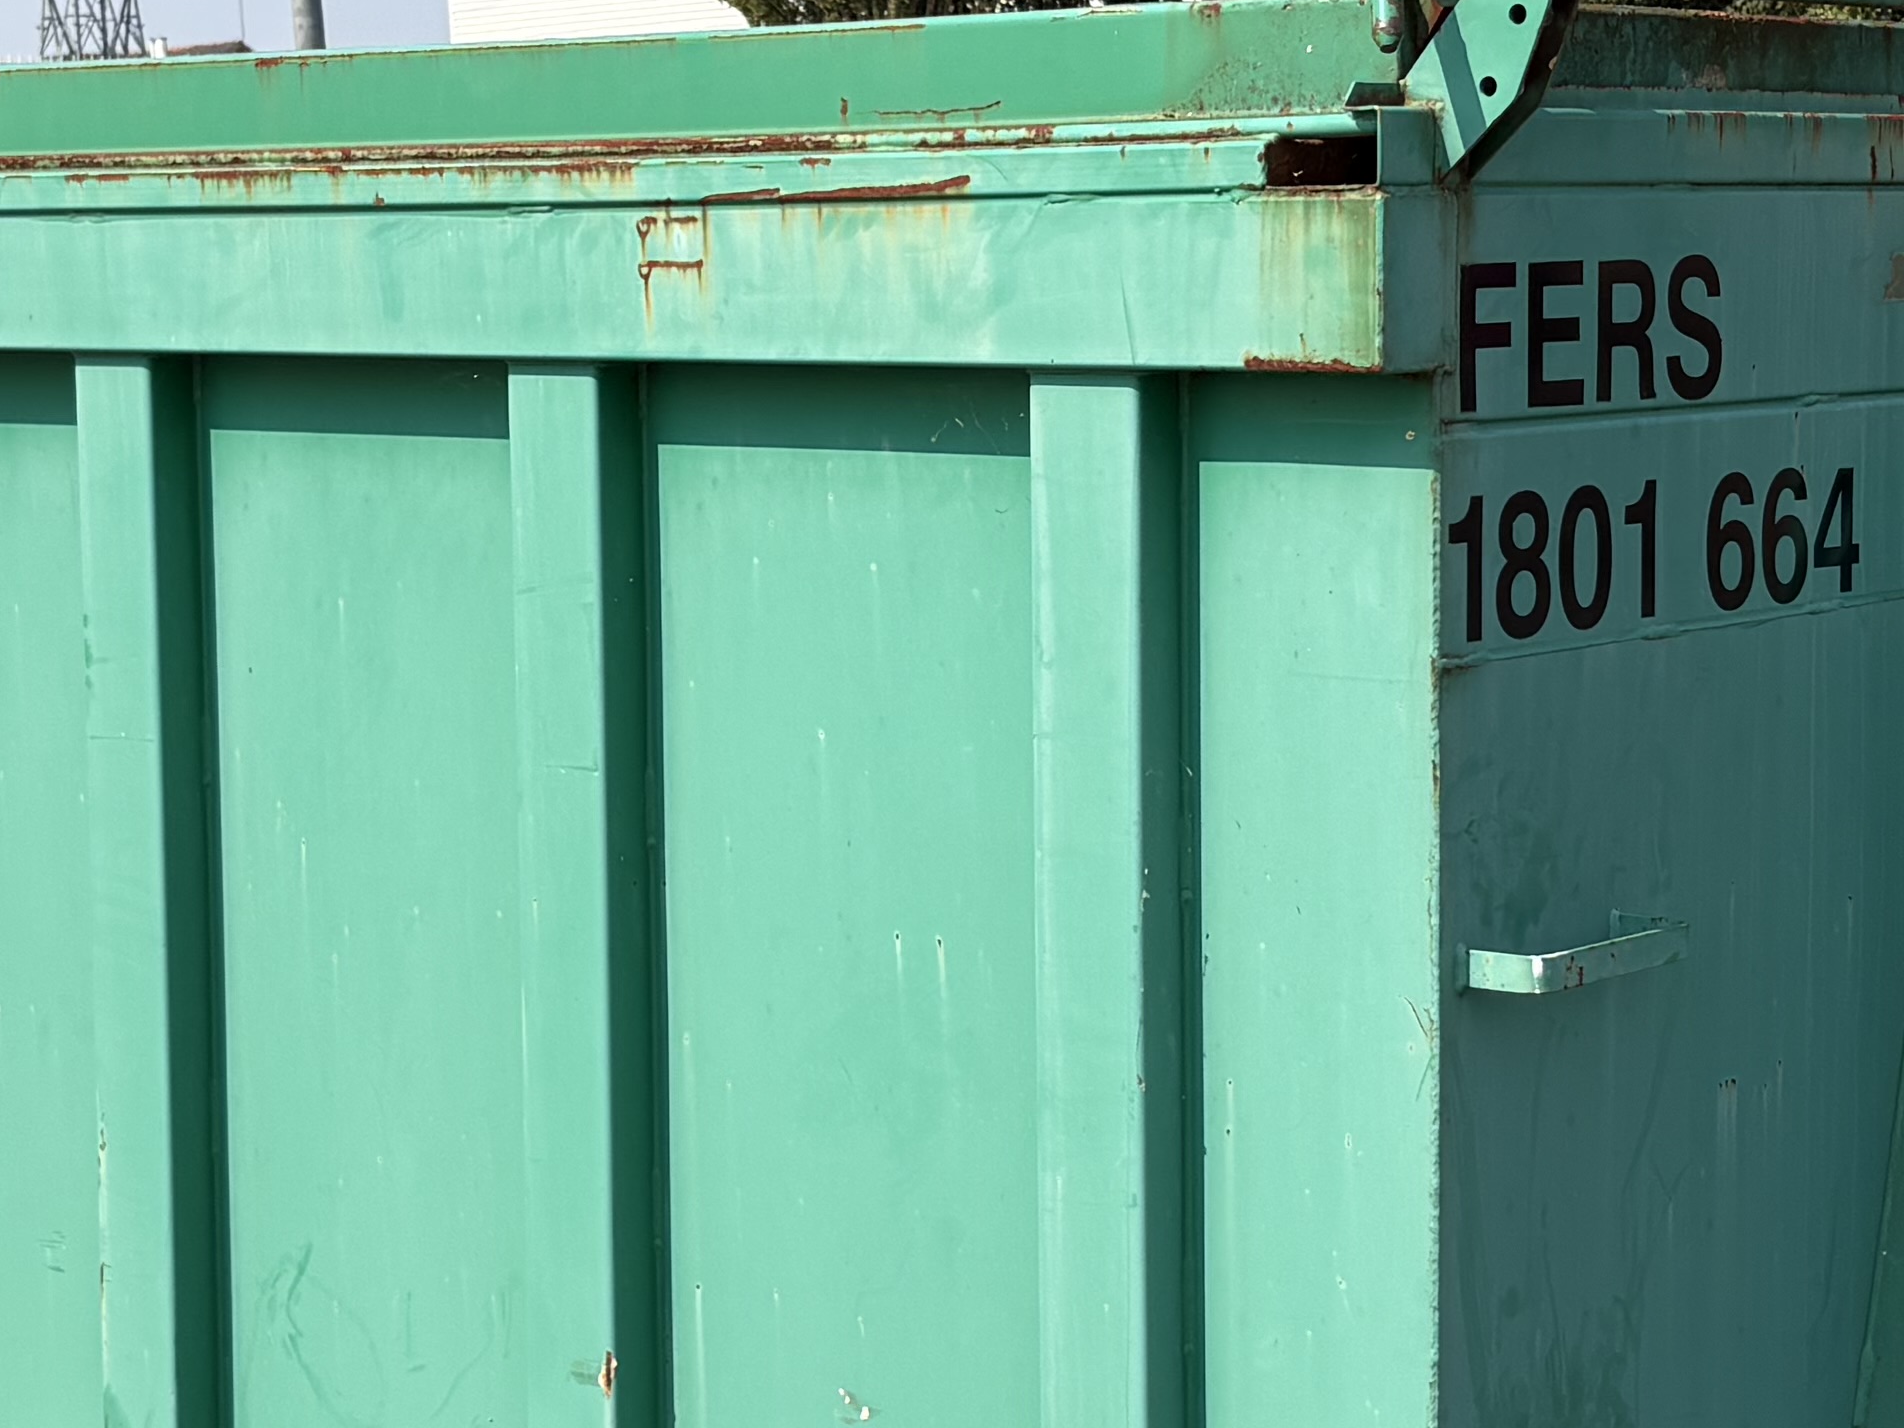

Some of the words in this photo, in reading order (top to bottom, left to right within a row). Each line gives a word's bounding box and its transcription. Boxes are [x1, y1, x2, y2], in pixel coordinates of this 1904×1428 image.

[1459, 254, 1723, 413] FERS
[1447, 484, 1657, 643] 1801
[1706, 466, 1860, 612] 664
